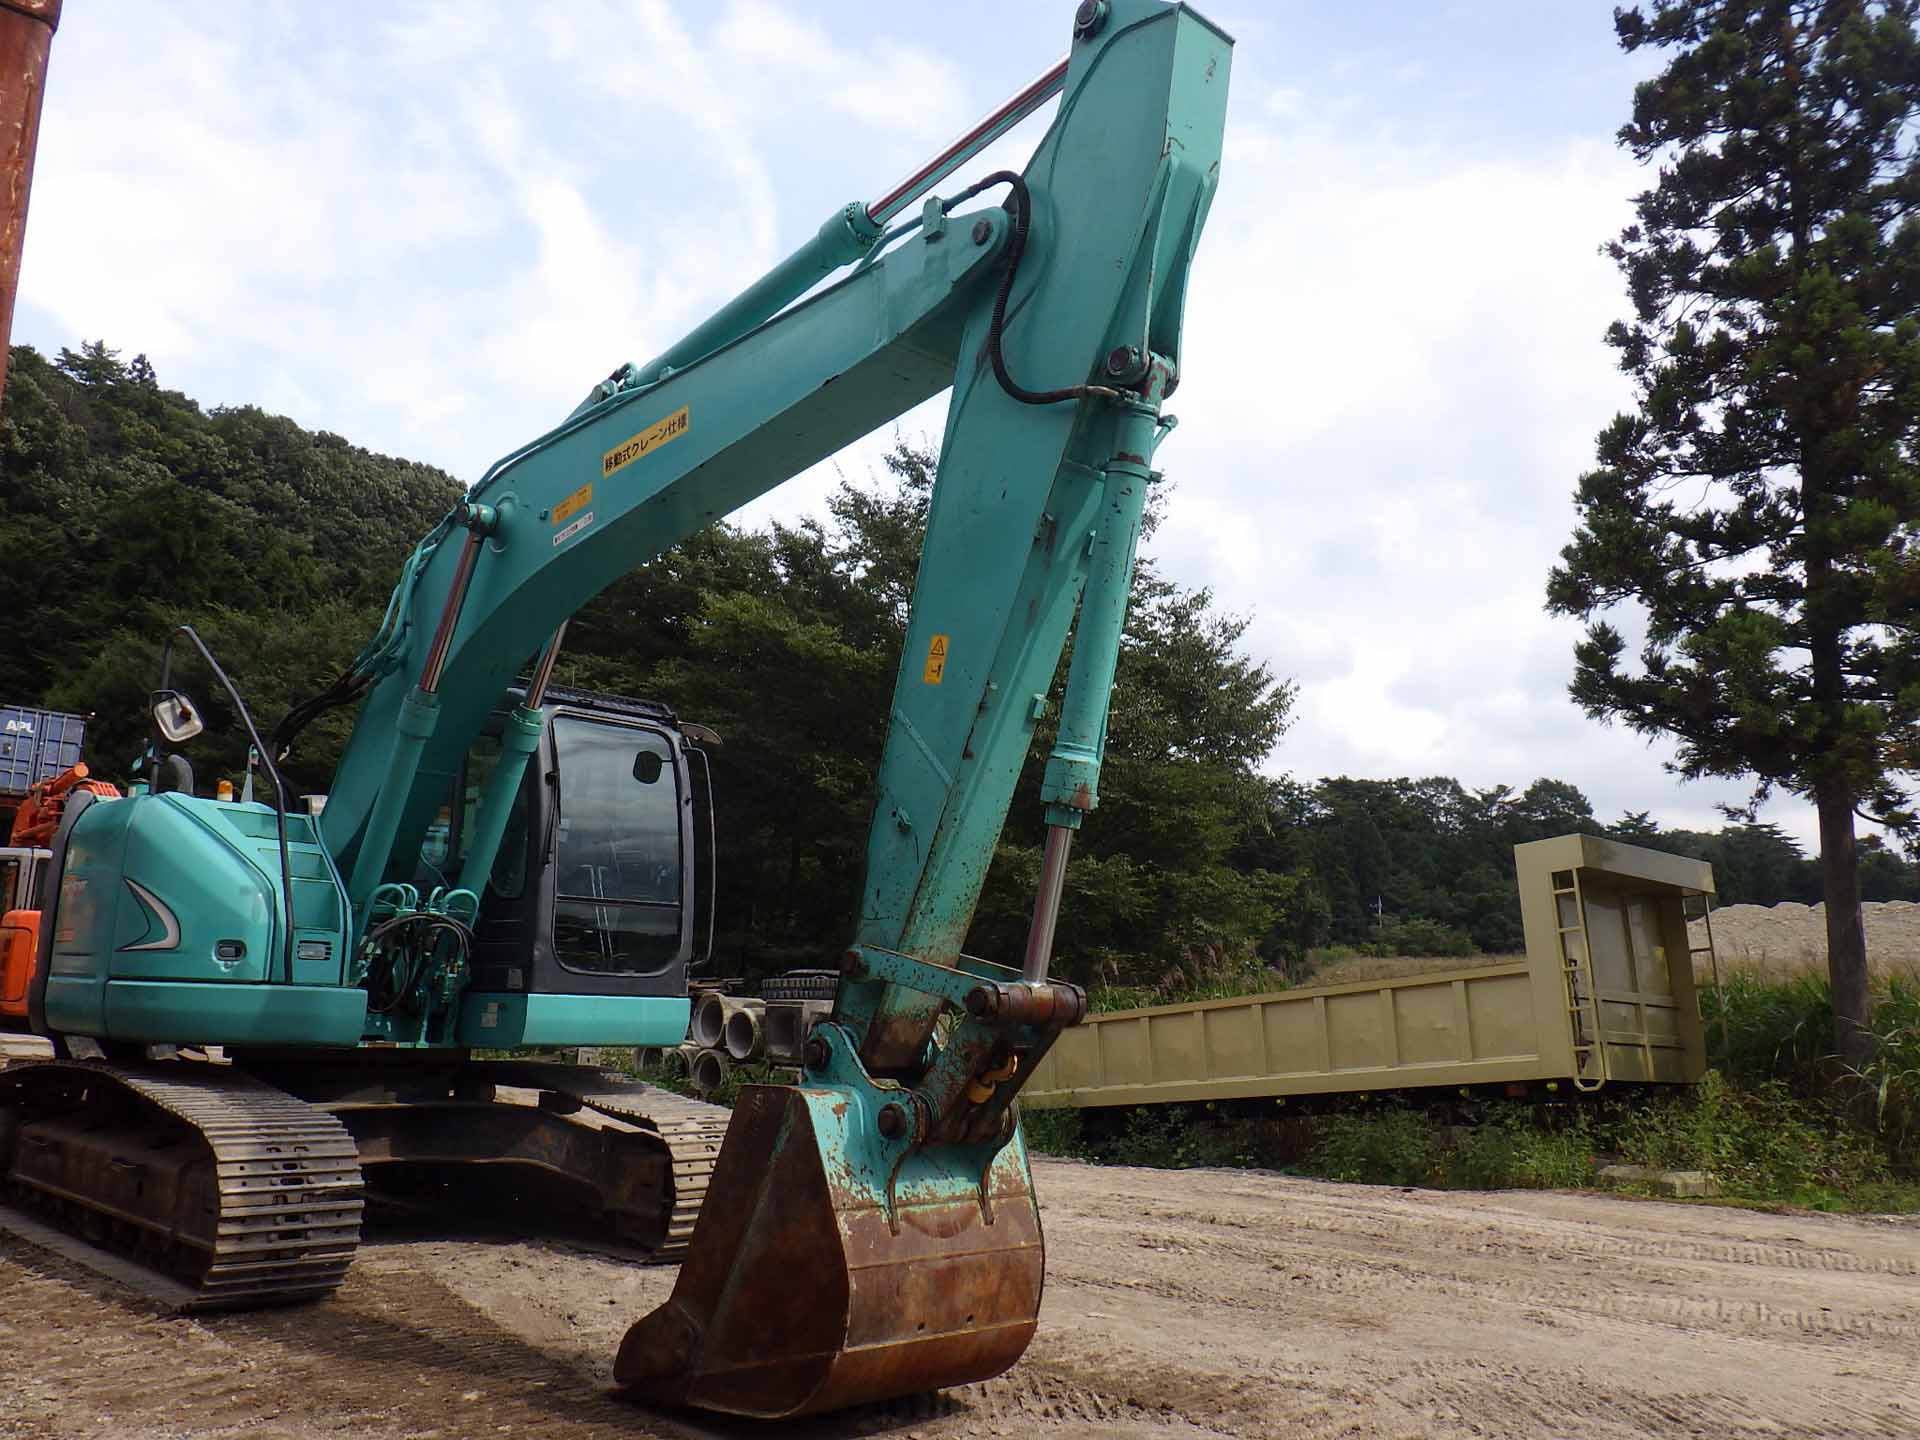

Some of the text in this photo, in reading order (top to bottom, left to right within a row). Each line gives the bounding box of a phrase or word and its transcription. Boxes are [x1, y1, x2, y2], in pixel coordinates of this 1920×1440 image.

[604, 412, 688, 472] 移動式クレーン仕様
[5, 719, 34, 733] APL
